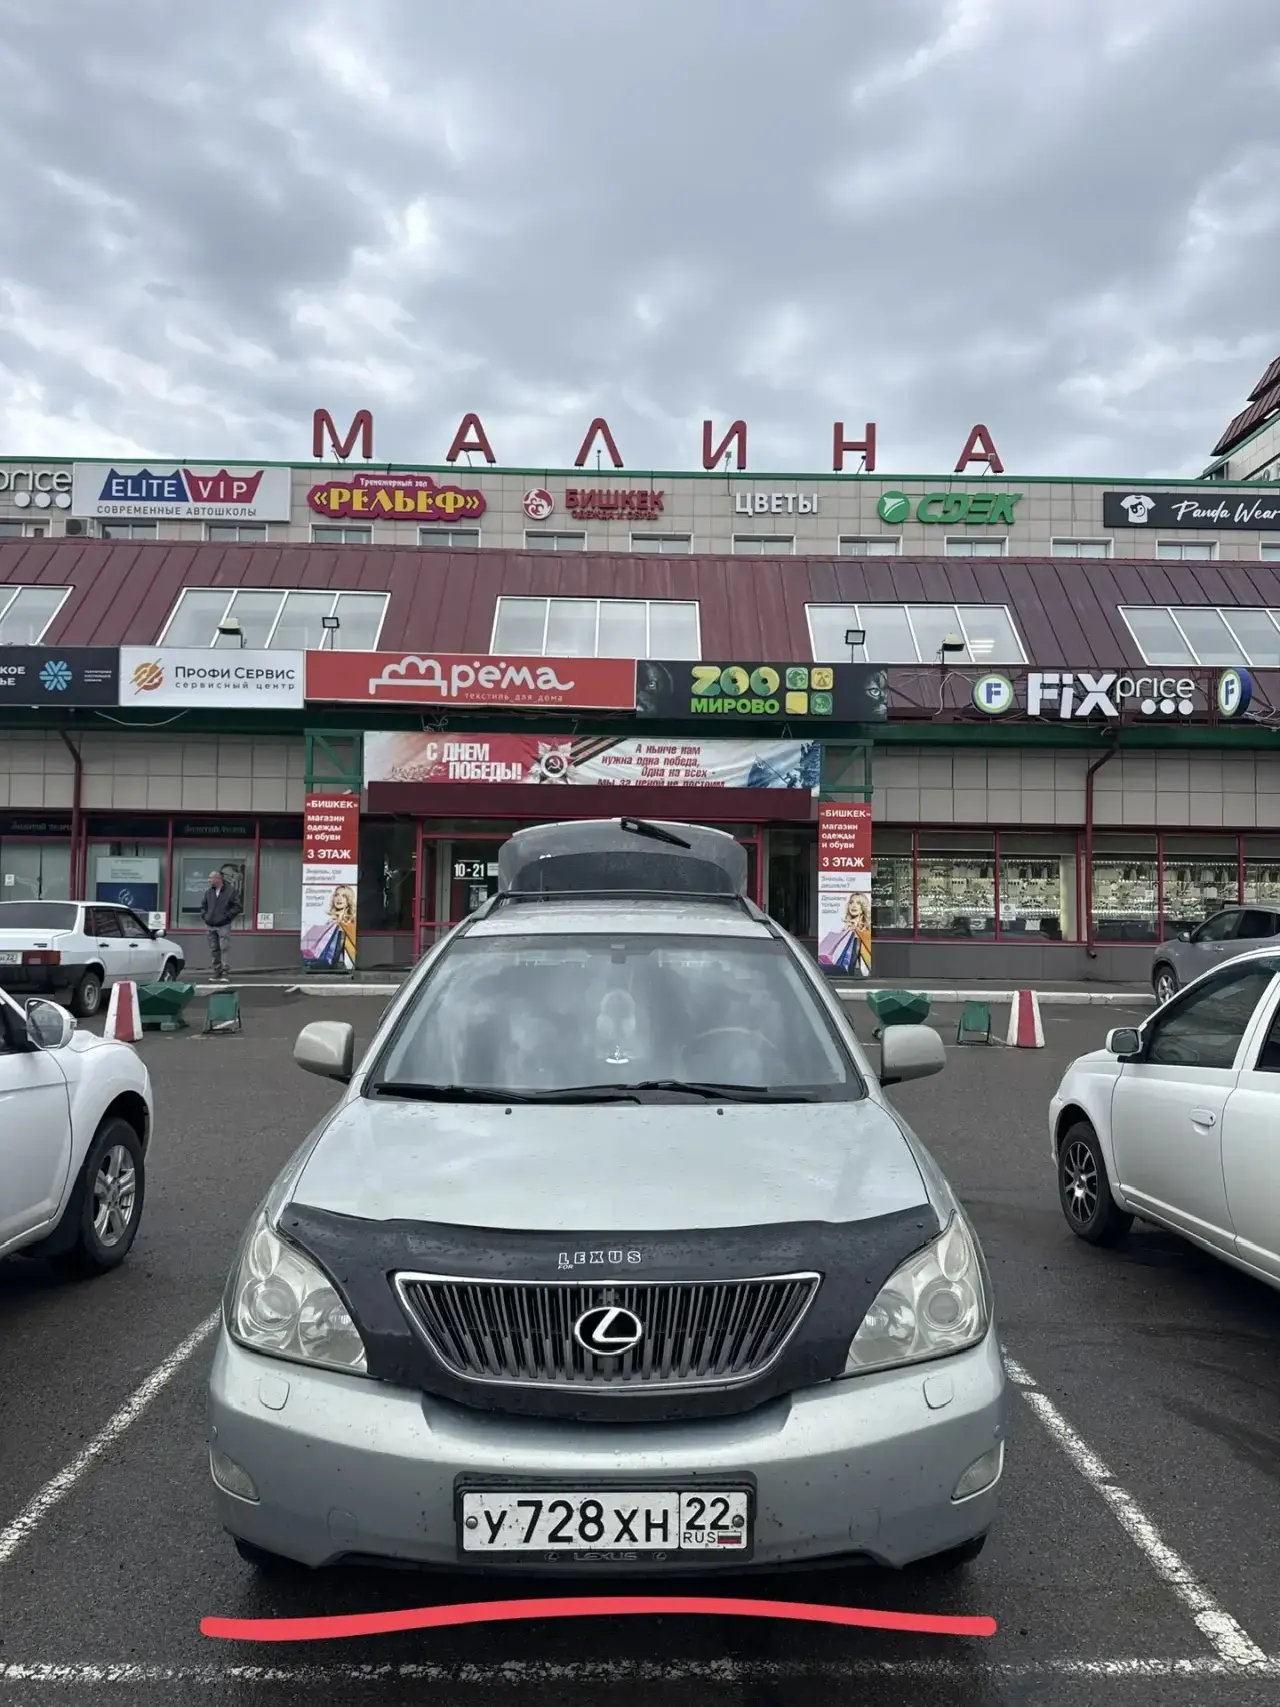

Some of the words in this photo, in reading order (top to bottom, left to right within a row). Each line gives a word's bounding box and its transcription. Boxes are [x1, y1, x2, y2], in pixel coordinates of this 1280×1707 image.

[313, 408, 1004, 472] МАЛИНА
[111, 478, 177, 497] ELITE
[198, 480, 247, 499] VIP
[313, 487, 480, 513] «РЕЛЬЕФ»
[565, 488, 665, 511] БИШКЕК
[735, 492, 818, 517] ЦВЕТЫ
[96, 505, 181, 516] СОВРЕМЕННЫЕ
[186, 507, 257, 517] АВТОШКОЛЫ
[1171, 500, 1230, 523] Panda
[1234, 498, 1280, 523] Wear
[175, 681, 249, 690] сервисный
[256, 682, 295, 691] центр
[690, 665, 780, 696] ZOO
[1115, 677, 1196, 703] price
[690, 698, 780, 715] МИРОВО
[426, 742, 438, 761] С
[442, 743, 490, 763] ДНЕМ
[635, 743, 642, 754] А
[646, 745, 677, 755] нынче
[681, 746, 701, 755] нам
[601, 755, 633, 767] нужна
[636, 756, 660, 768] одна
[449, 761, 522, 782] ПОБЕДЫ!
[641, 766, 665, 778] Одна
[684, 769, 708, 778] всех
[307, 824, 342, 833] одежды
[822, 823, 858, 831] магазин
[315, 833, 341, 842] обуви
[822, 832, 855, 840] одежды
[829, 841, 855, 850] обуви
[307, 849, 315, 859] 3
[317, 849, 351, 859] ЭТАЖ
[823, 857, 830, 867] 3
[832, 857, 865, 867] ЭТАЖ
[558, 1250, 641, 1265] LEXUS
[685, 1497, 731, 1530] 22
[683, 1531, 716, 1544] RUS
[573, 1551, 638, 1561] LEXUS
